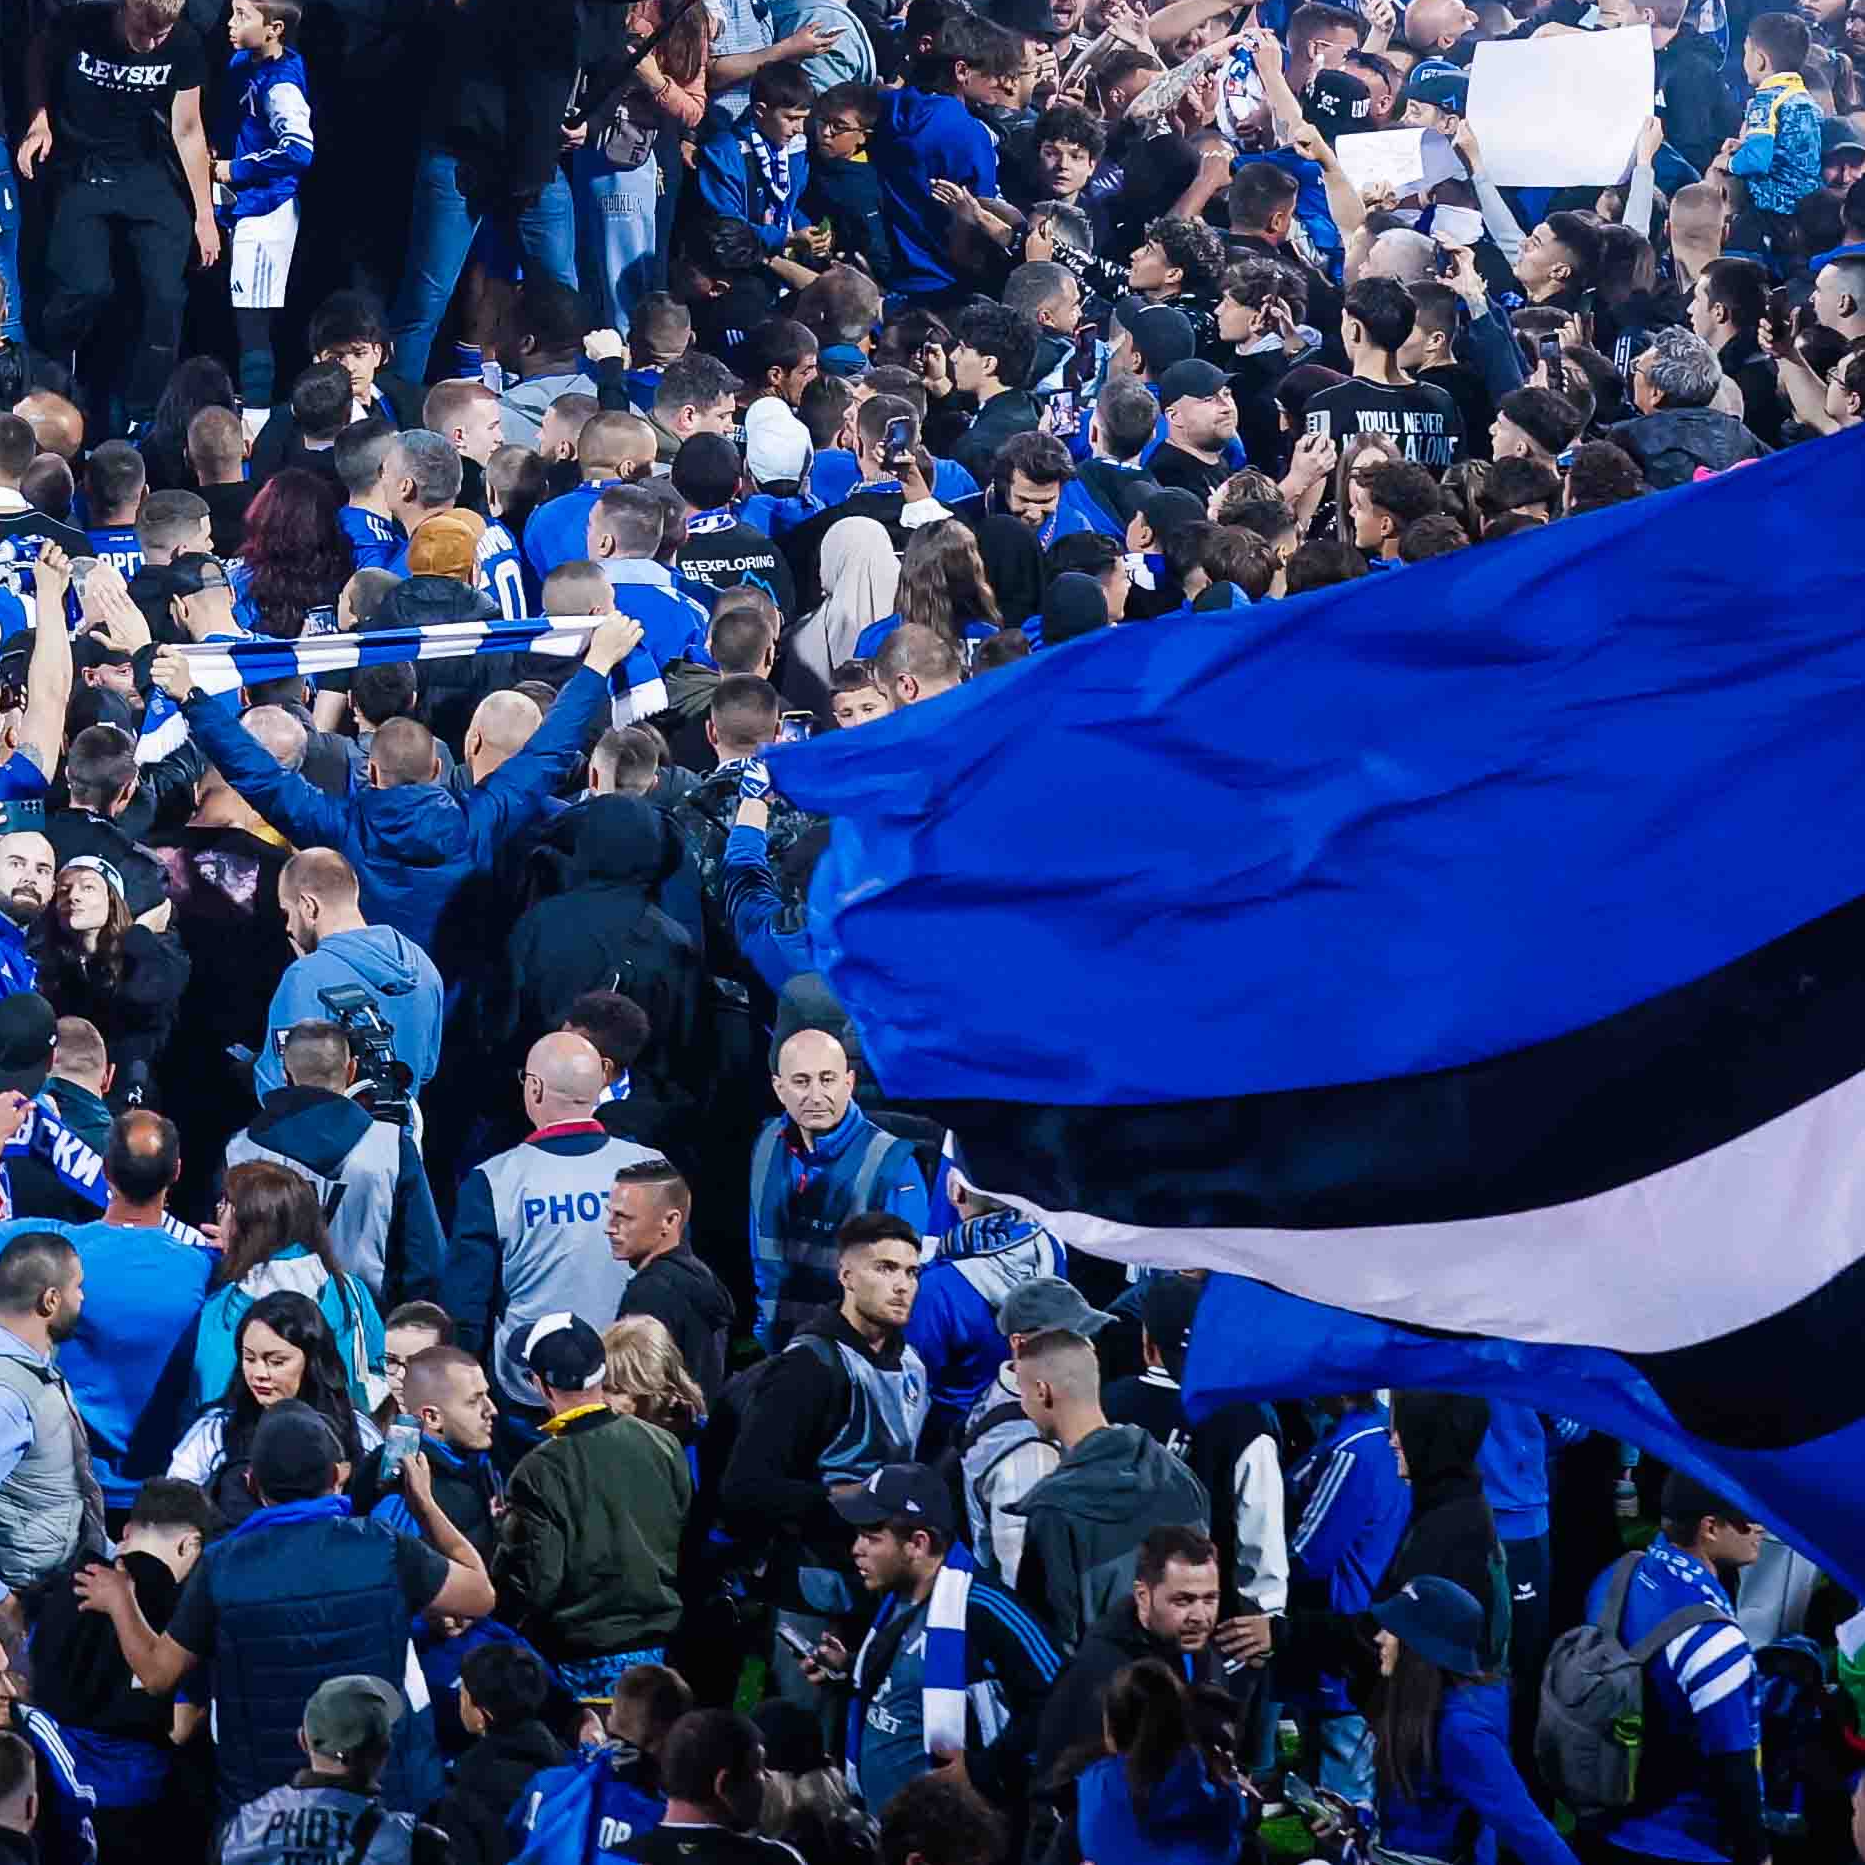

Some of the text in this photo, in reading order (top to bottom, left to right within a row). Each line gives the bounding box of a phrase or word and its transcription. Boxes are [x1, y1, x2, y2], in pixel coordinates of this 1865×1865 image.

[78, 51, 172, 87] LEVSKI
[1355, 410, 1446, 434] YOU'LL NEVER
[697, 556, 775, 574] EXPLORING
[268, 1806, 352, 1846] PHOT
